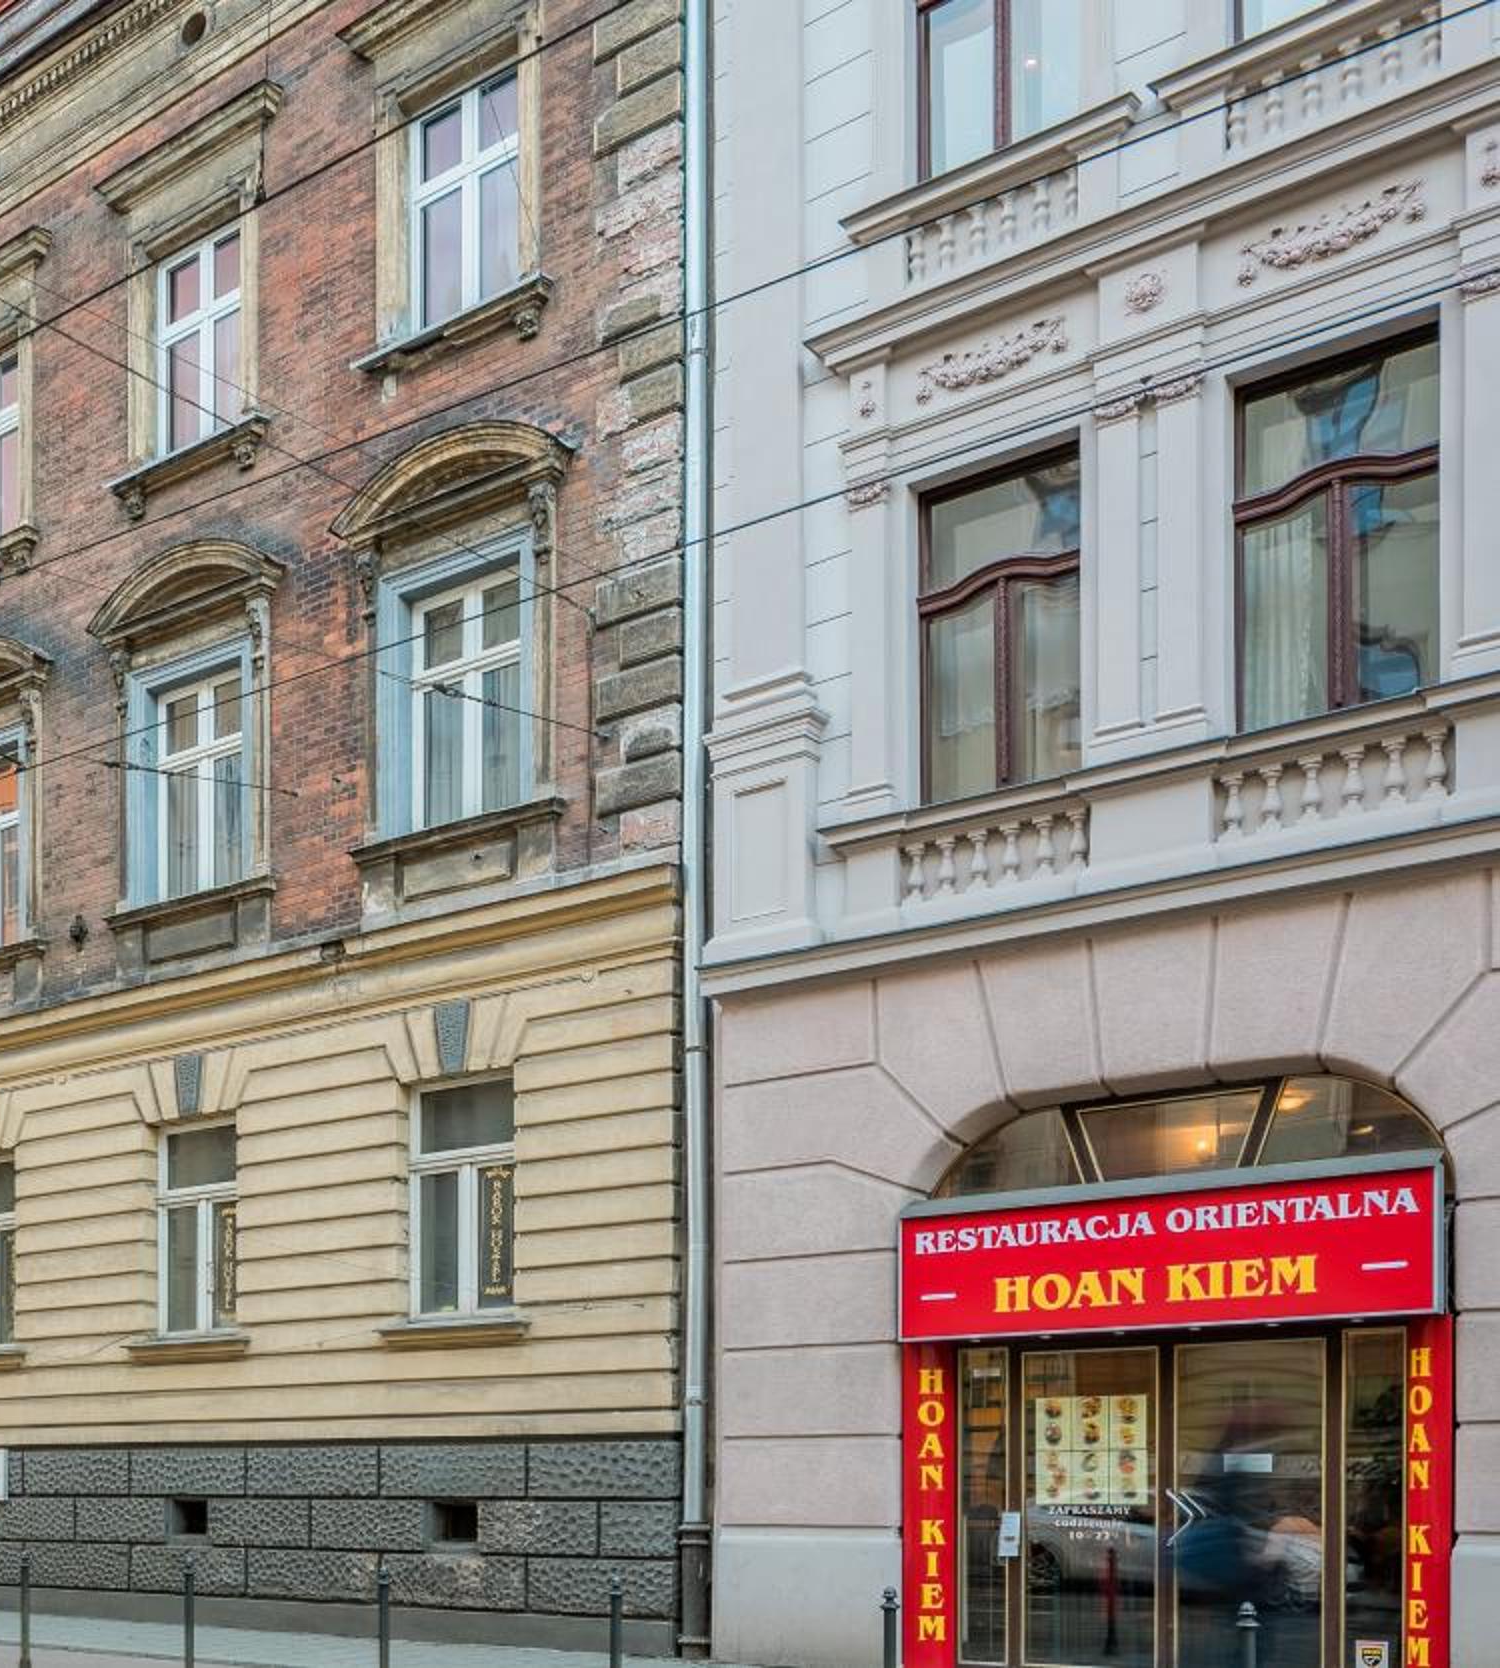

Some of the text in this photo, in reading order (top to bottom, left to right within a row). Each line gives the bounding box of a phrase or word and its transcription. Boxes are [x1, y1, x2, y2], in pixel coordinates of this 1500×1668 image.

[915, 1187, 1420, 1255] RESTAURACJA ORIENTALNA
[993, 1254, 1318, 1314] HOAN KIEM
[917, 1368, 946, 1642] HOAN KIEM
[1407, 1347, 1433, 1668] HOAN KIEM
